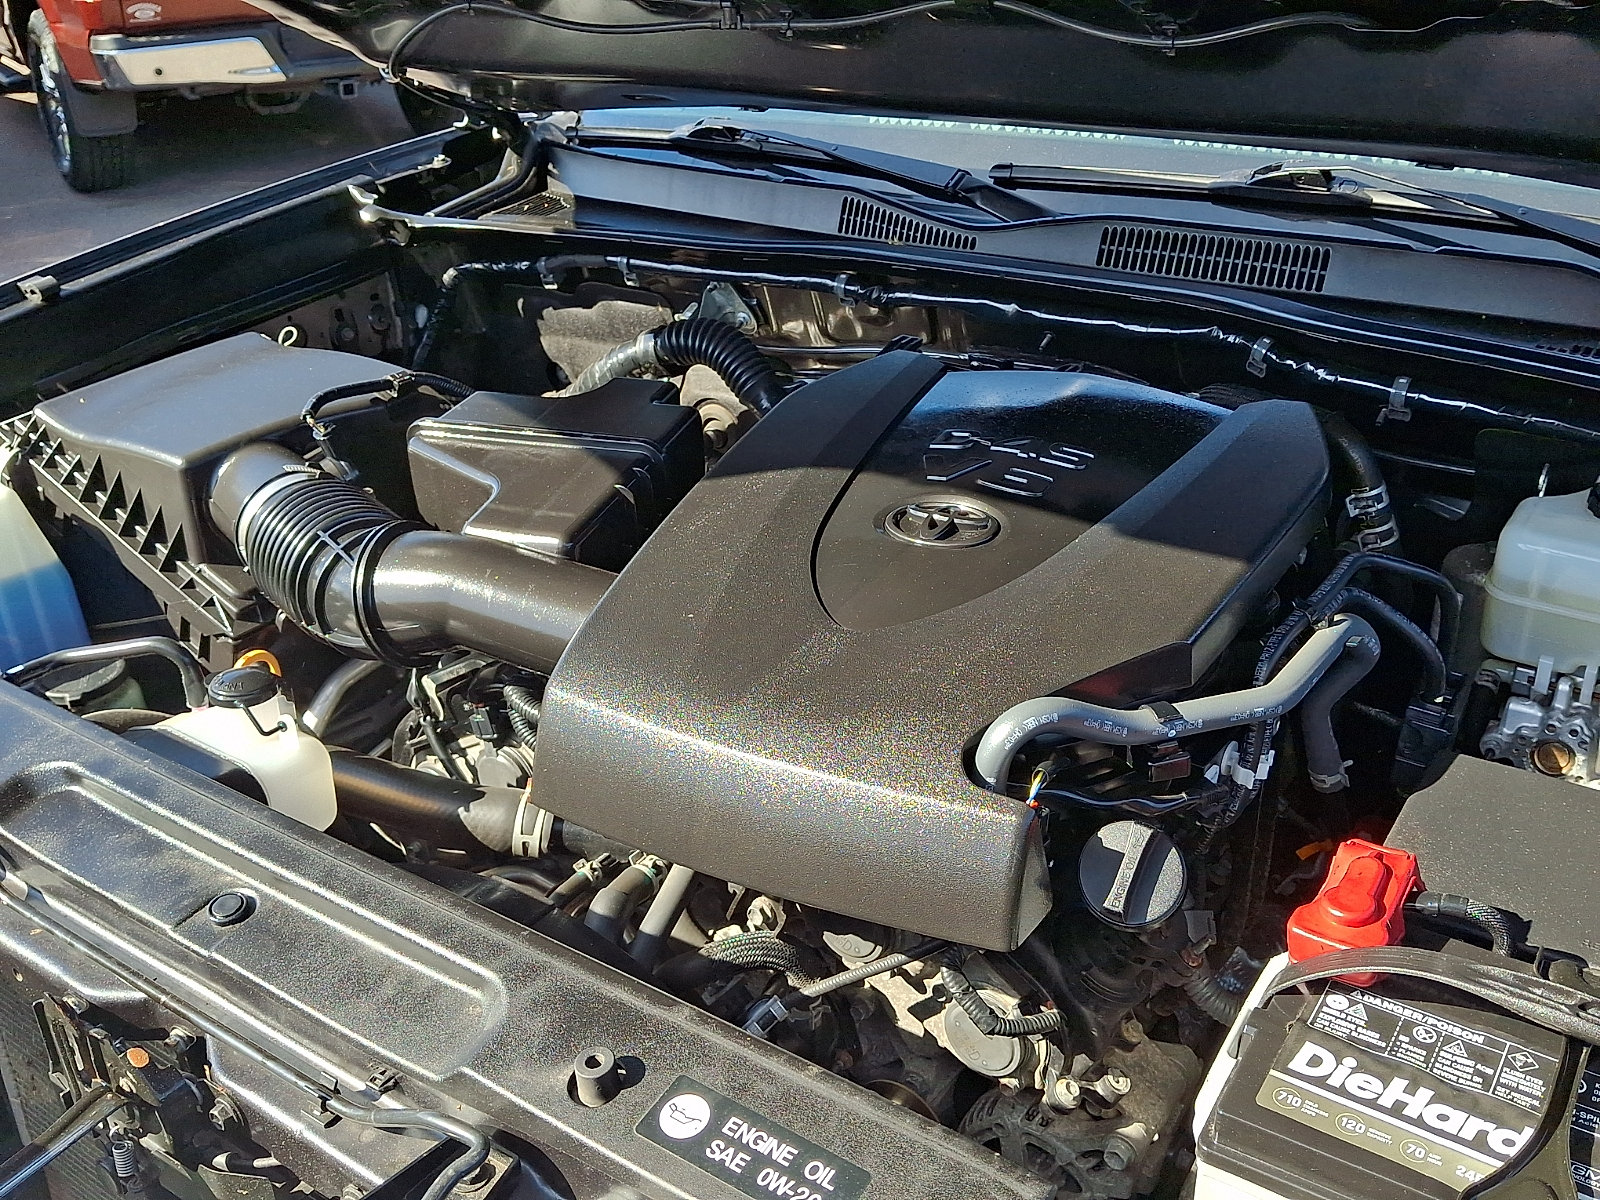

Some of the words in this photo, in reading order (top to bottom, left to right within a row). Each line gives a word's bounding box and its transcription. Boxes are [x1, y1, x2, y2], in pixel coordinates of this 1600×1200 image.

[1110, 870, 1131, 908] ENGINE
[1126, 852, 1138, 870] OIL
[1362, 994, 1485, 1044] DANGER/POISON
[1277, 1090, 1302, 1108] 710
[1288, 1041, 1534, 1157] DieHard
[1341, 1116, 1366, 1134] 120
[706, 1140, 752, 1174] SAE
[722, 1117, 798, 1167] ENGINE
[804, 1161, 836, 1191] OIL
[1406, 1143, 1426, 1159] 70
